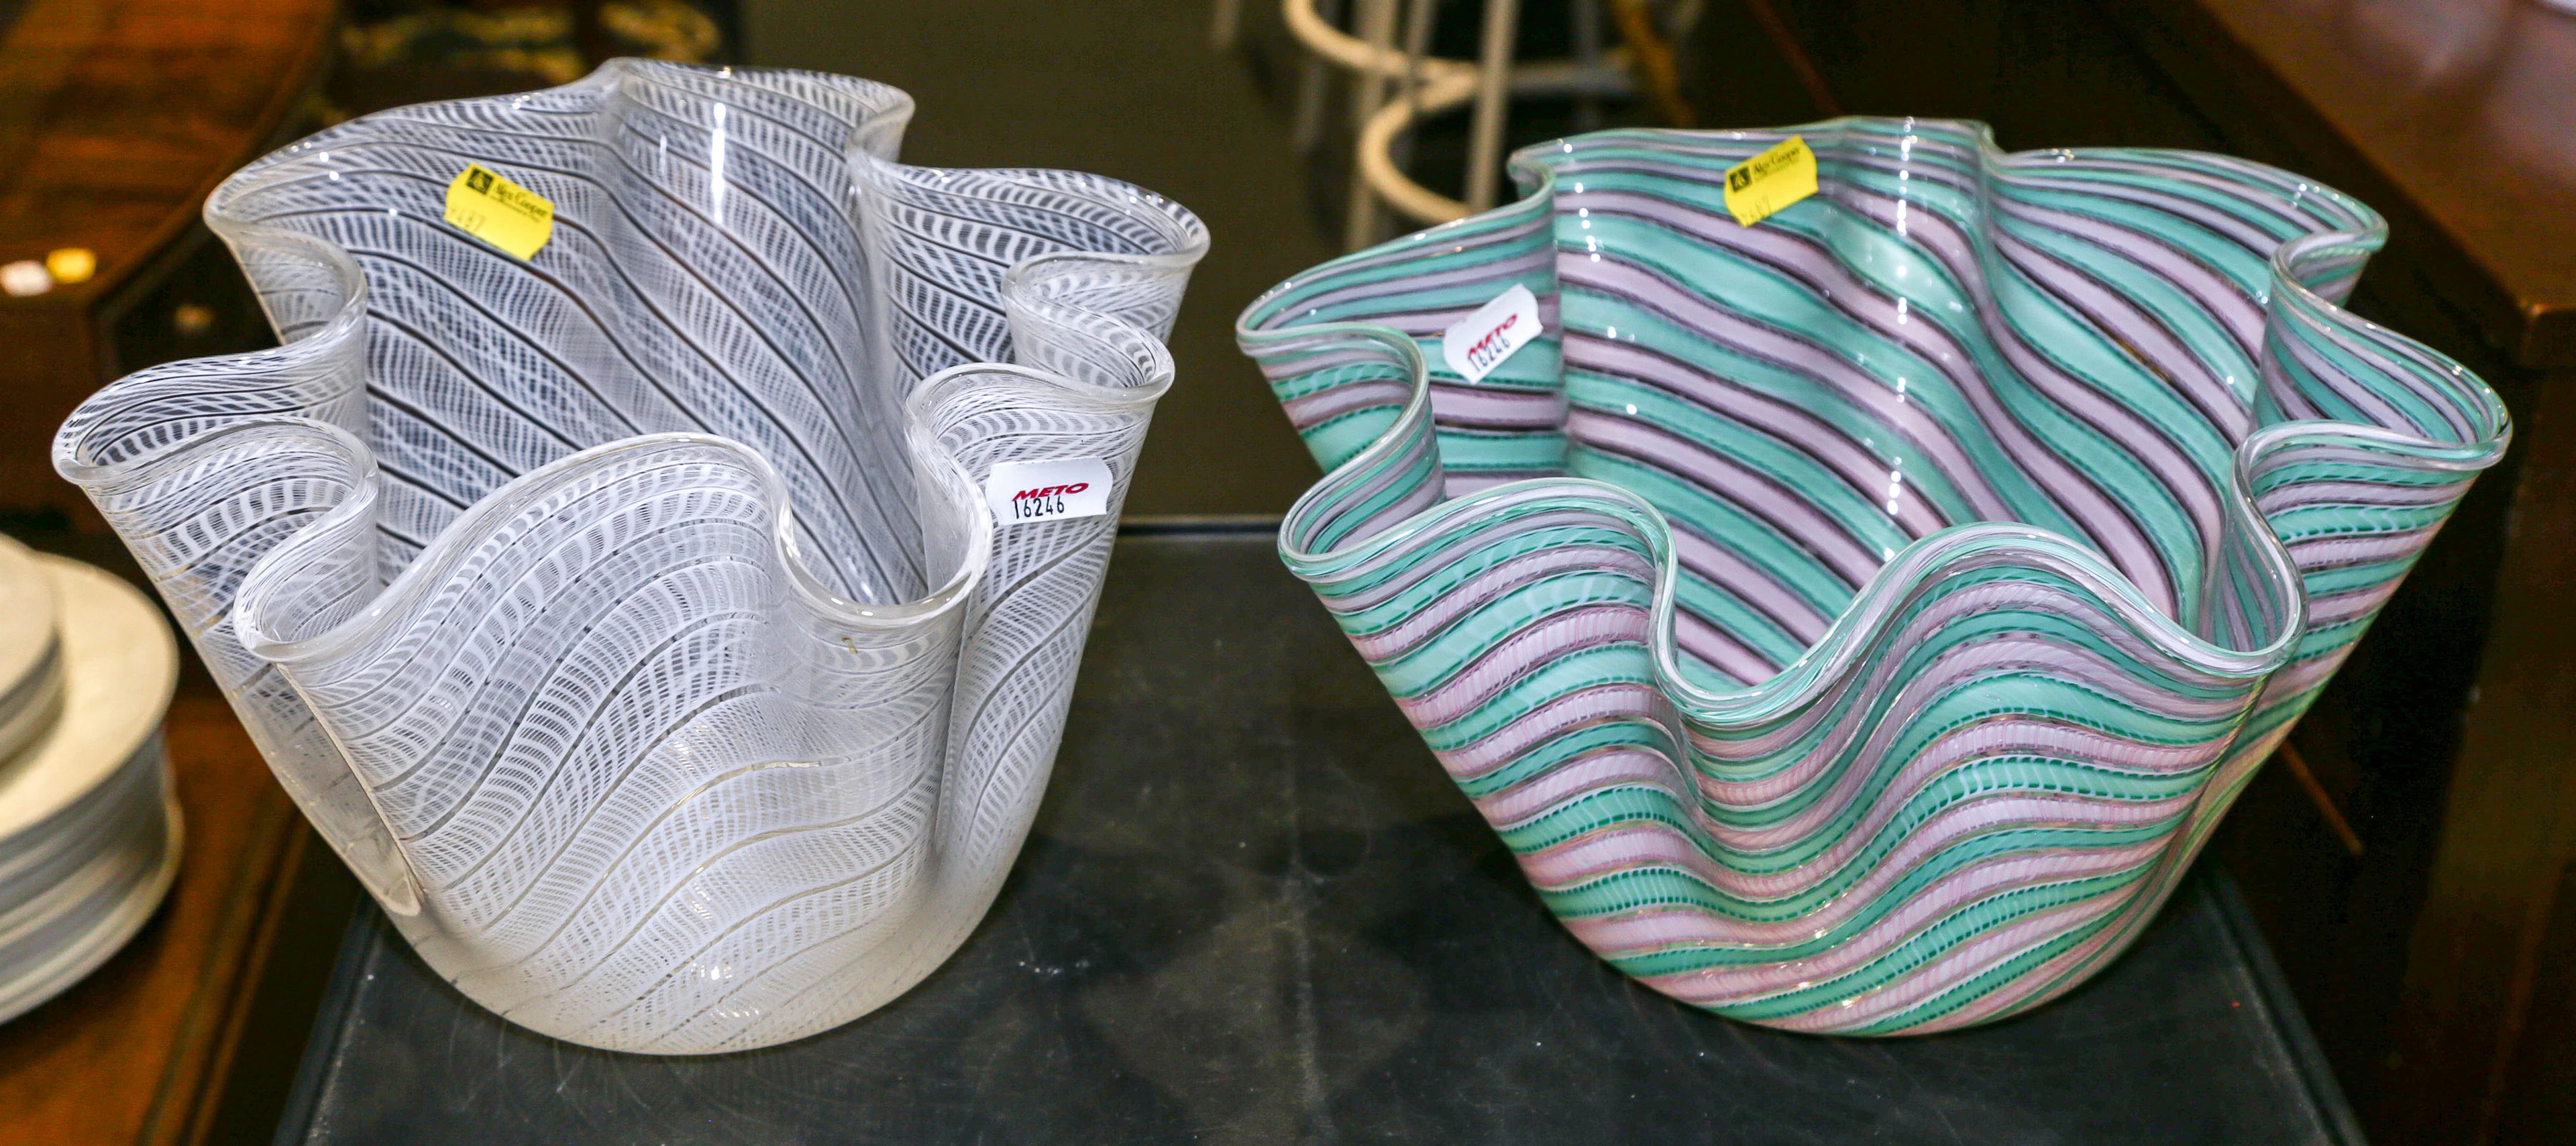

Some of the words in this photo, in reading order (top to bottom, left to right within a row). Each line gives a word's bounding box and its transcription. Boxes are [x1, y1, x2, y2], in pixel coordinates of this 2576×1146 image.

[515, 192, 549, 219] Cooper
[1468, 313, 1518, 359] METO
[1011, 482, 1089, 502] METO
[1014, 495, 1065, 520] 16246
